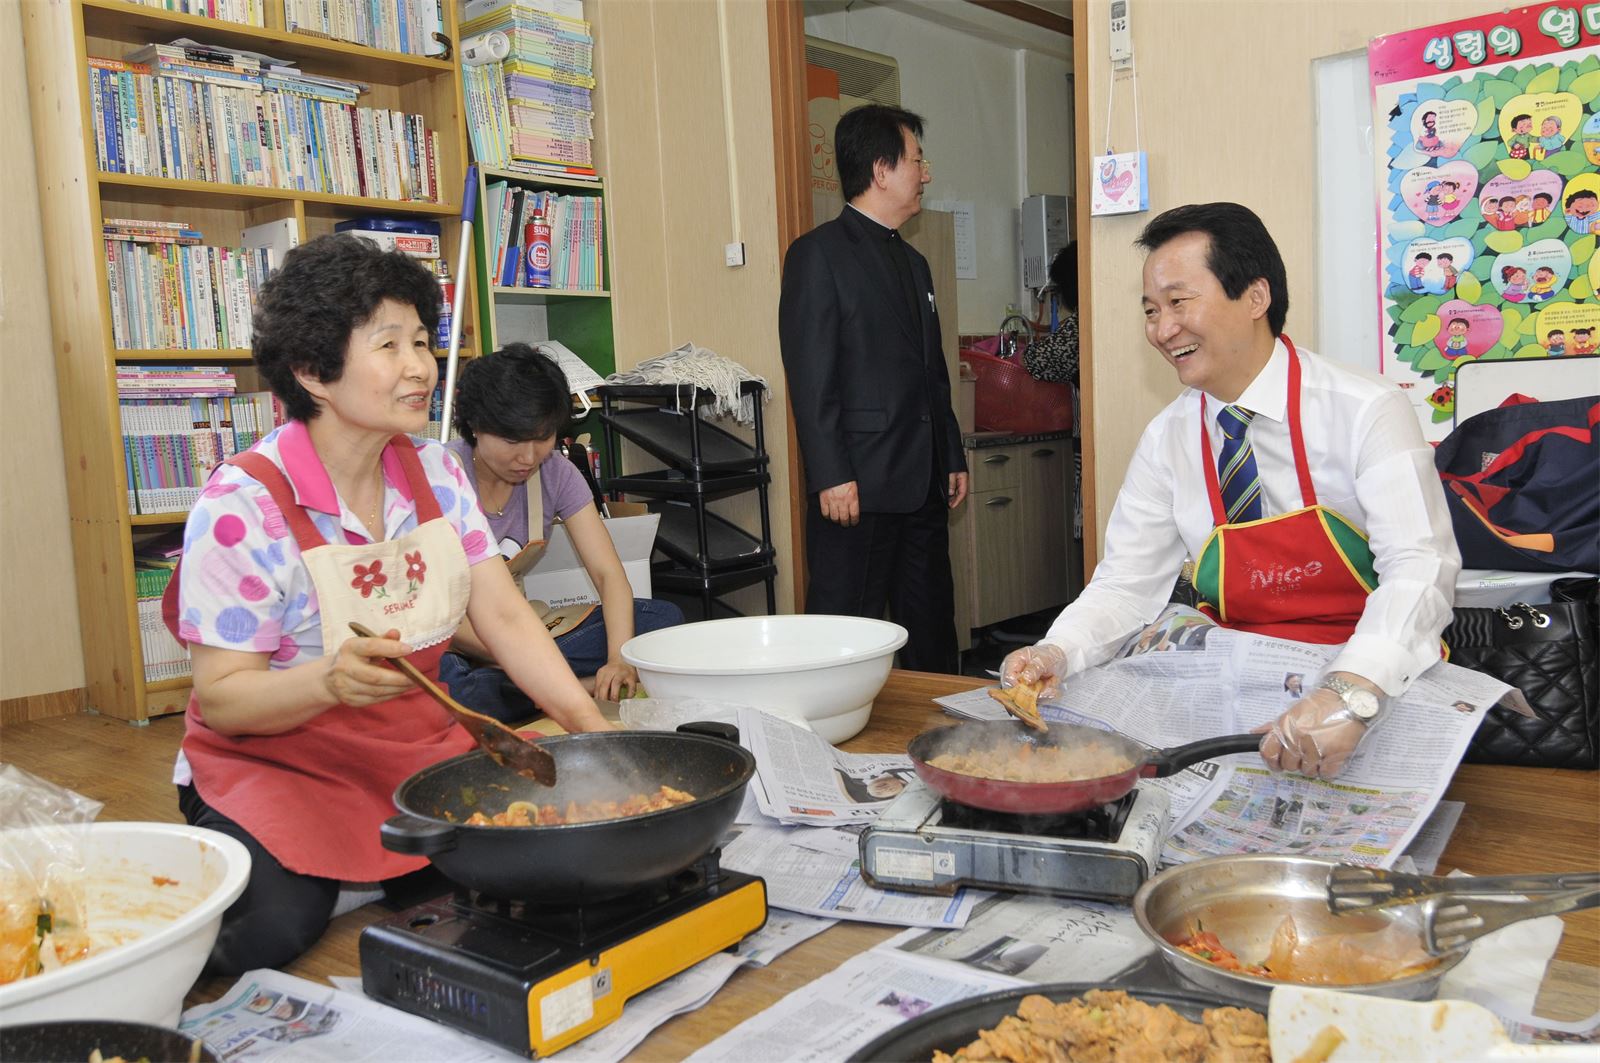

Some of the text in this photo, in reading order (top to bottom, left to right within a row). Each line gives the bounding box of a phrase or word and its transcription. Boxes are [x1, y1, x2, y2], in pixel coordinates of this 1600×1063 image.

[1424, 25, 1521, 69] 성령의
[533, 225, 550, 235] SUN
[1250, 560, 1322, 591] Nice
